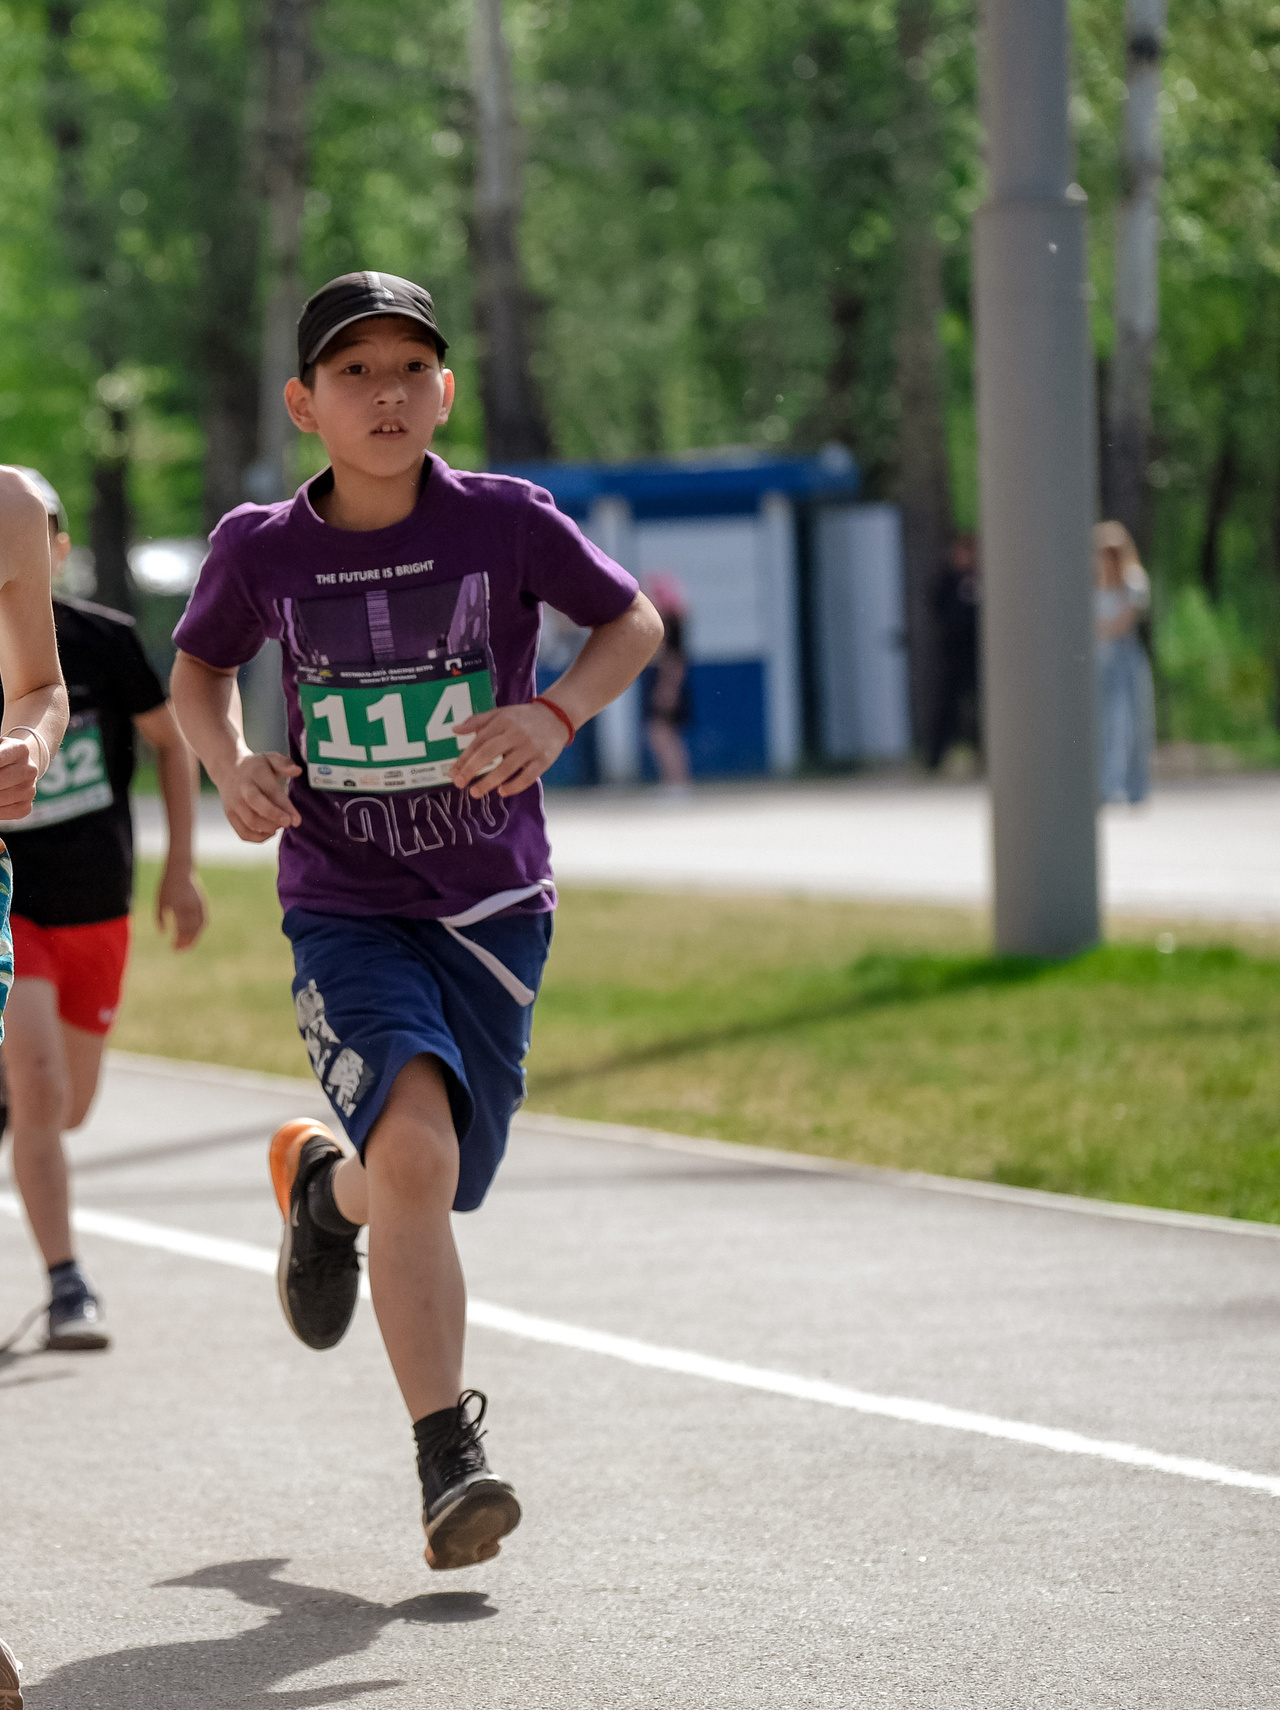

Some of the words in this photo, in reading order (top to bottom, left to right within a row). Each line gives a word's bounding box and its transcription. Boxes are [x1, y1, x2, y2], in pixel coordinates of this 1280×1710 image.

[315, 573, 337, 585] THE
[338, 569, 381, 583] FUTURE
[382, 567, 393, 578] IS
[395, 559, 435, 577] BRIGHT
[312, 682, 477, 762] 114
